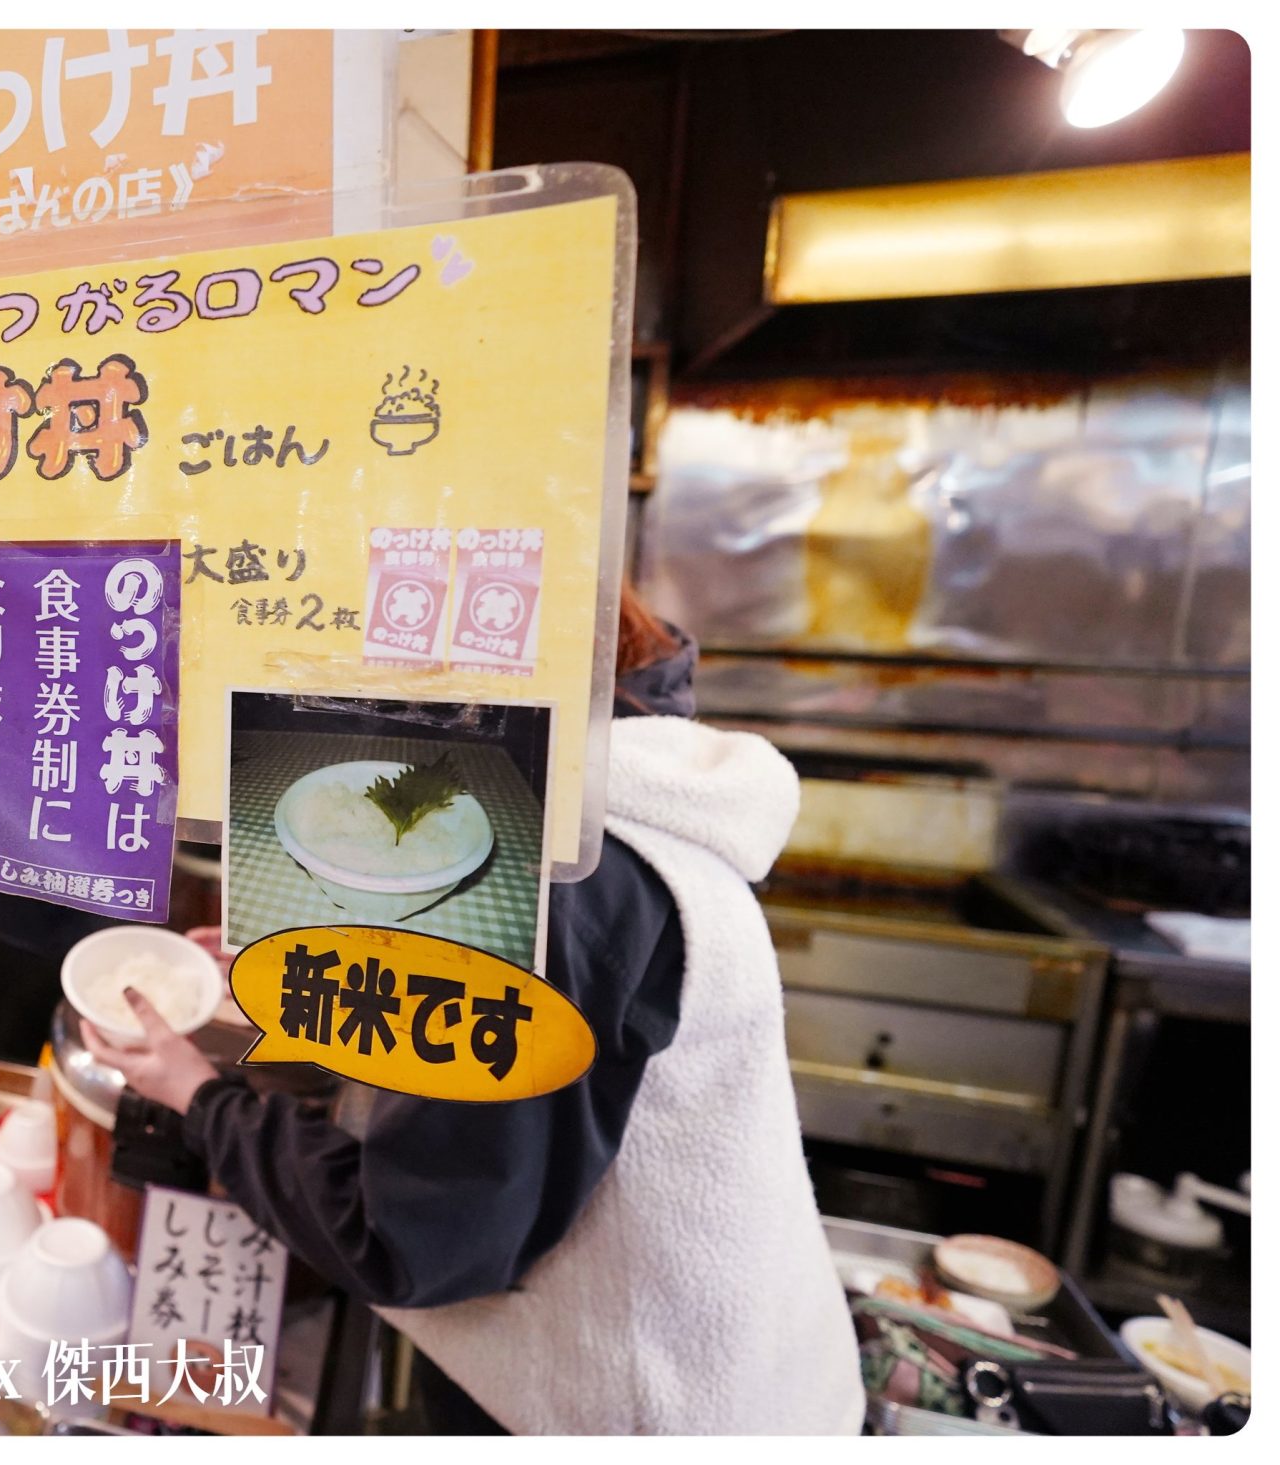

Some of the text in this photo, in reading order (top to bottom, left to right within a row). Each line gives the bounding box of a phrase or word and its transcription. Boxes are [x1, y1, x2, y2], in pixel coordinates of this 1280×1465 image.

[179, 423, 331, 476] ごはん
[183, 538, 307, 585] 大盛り
[29, 568, 82, 843] 食事券制に
[99, 558, 166, 853] のっけ丼は
[279, 943, 534, 1082] 新米です
